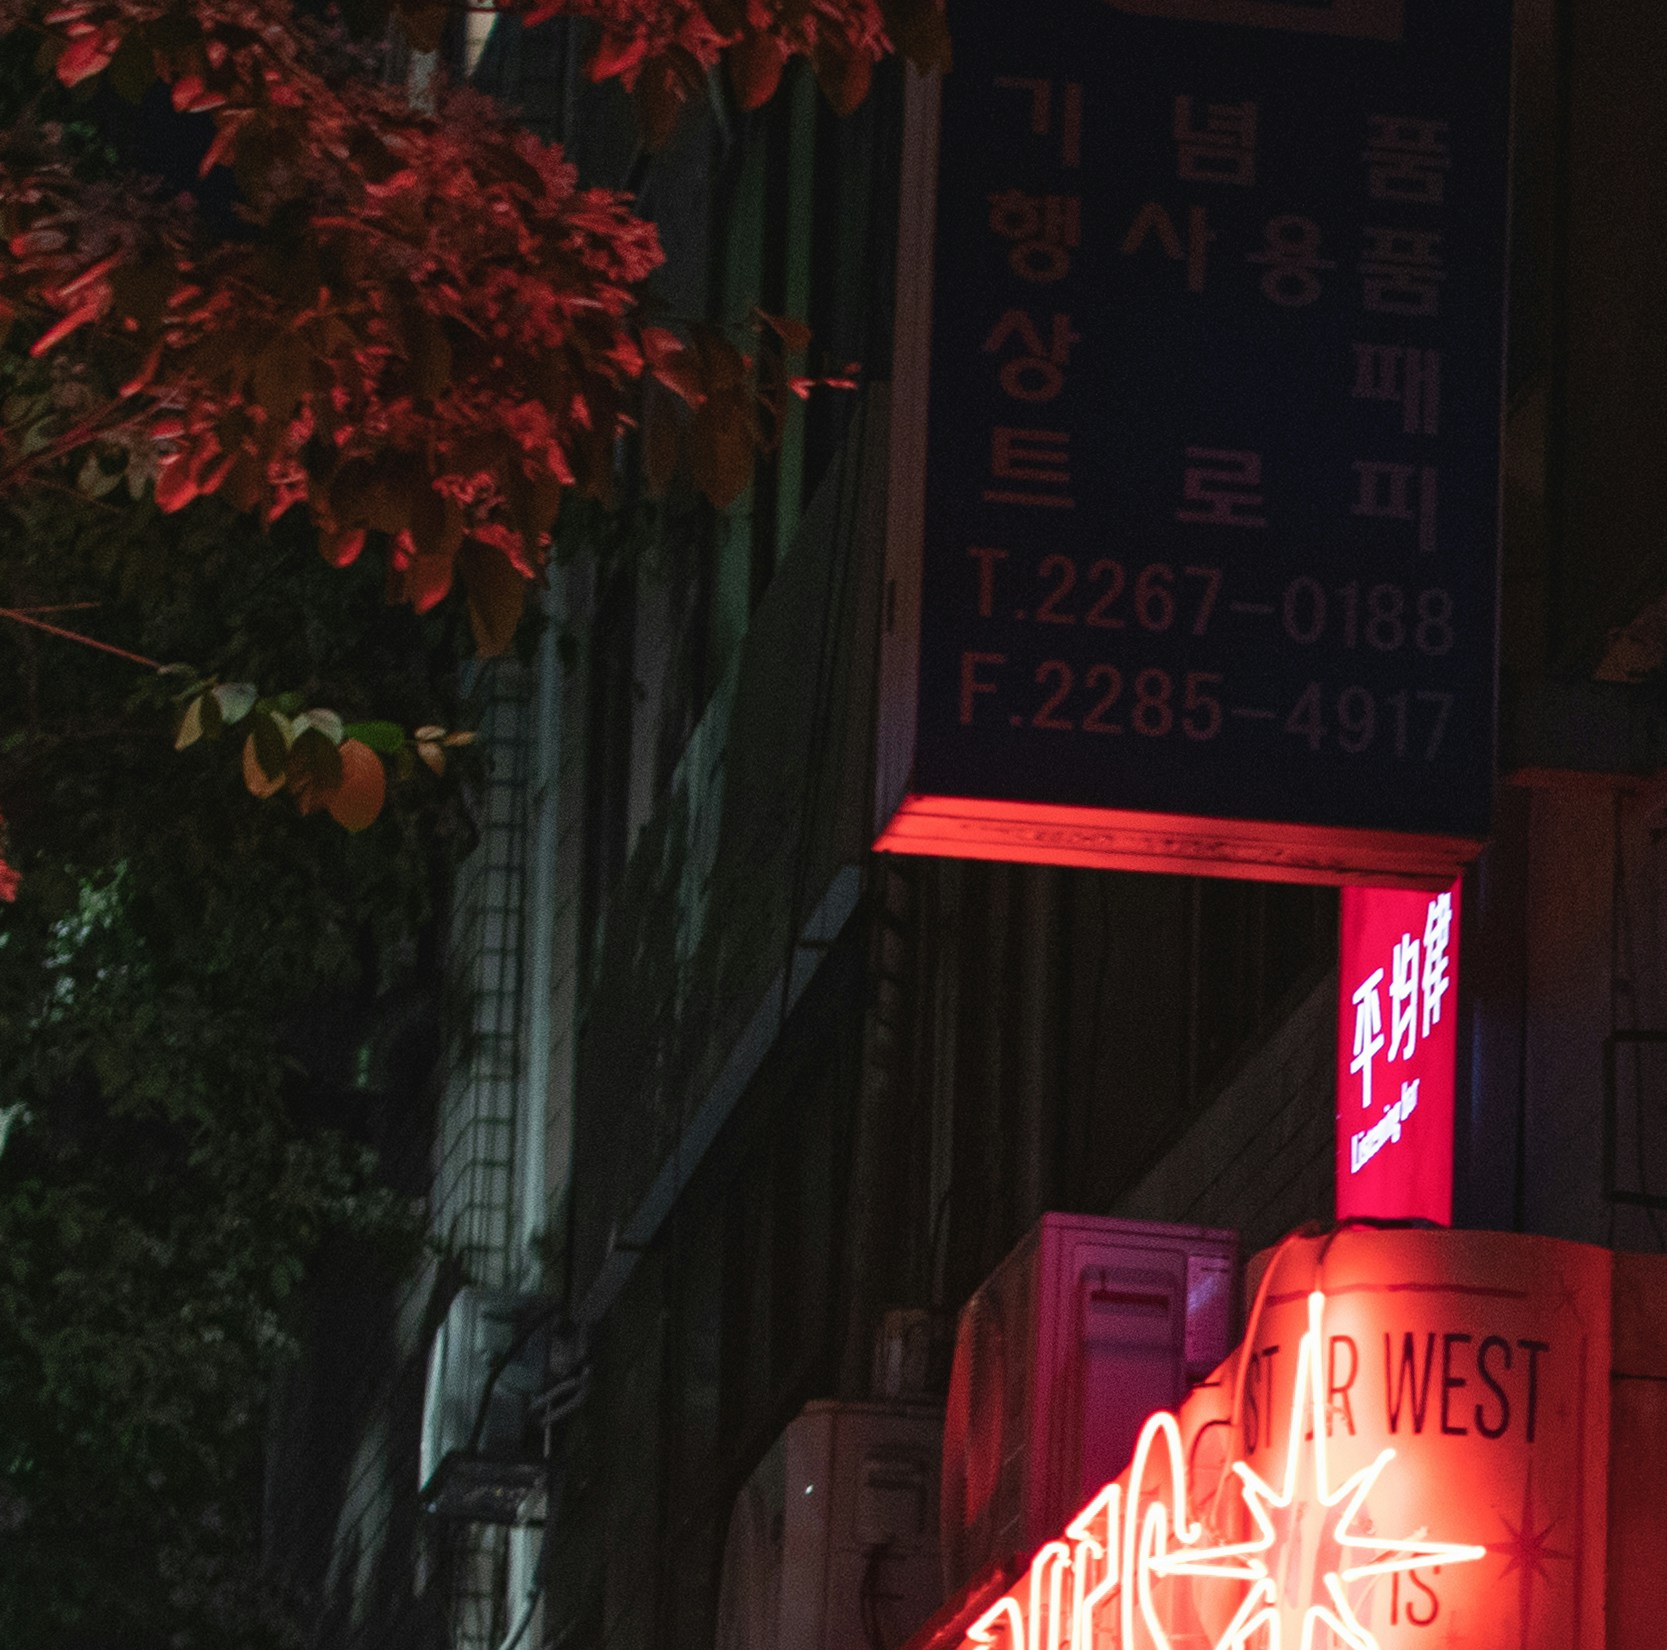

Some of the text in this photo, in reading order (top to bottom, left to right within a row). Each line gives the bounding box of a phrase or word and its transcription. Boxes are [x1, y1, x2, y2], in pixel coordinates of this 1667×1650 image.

[968, 545, 1455, 656] T.2267-0188
[959, 652, 1454, 760] F.2285-4917
[1384, 1332, 1548, 1442] WEST
[1390, 1556, 1442, 1627] IS
